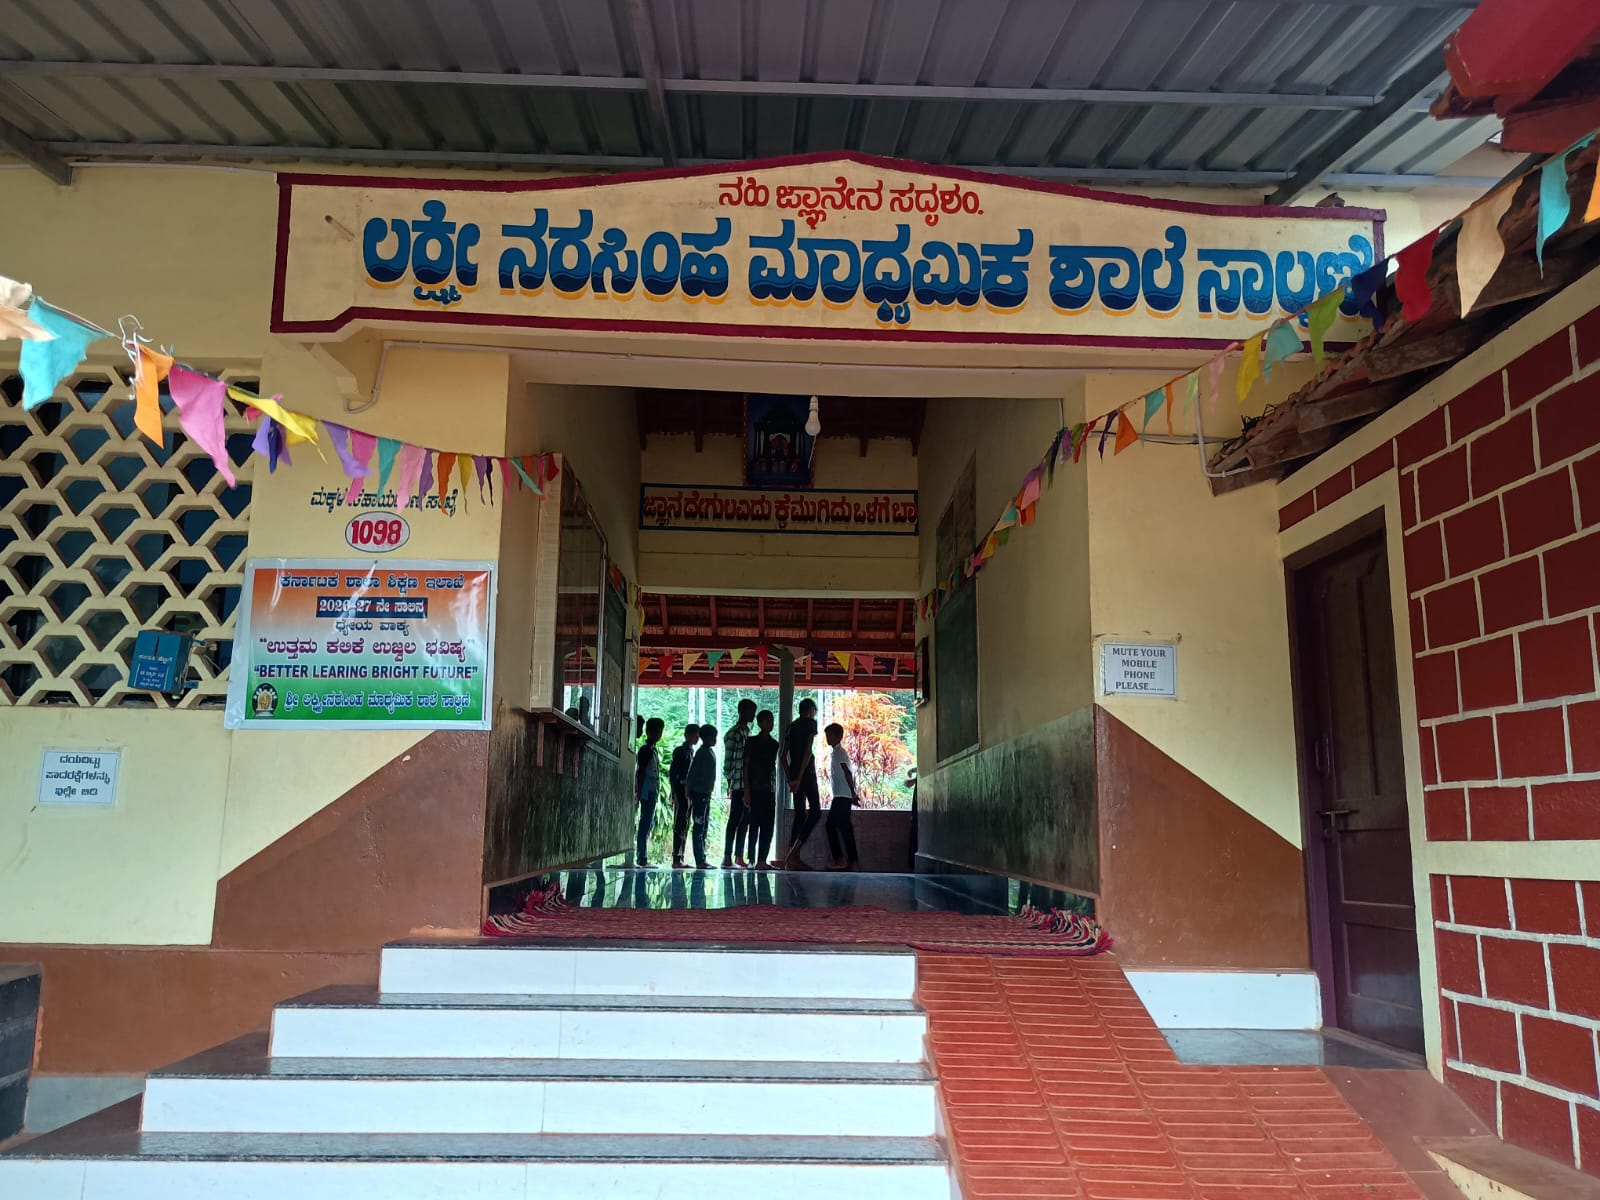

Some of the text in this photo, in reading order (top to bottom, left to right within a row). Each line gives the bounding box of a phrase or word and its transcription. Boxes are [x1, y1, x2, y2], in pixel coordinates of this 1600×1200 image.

[498, 207, 732, 304] ನರಸಿಂಹ
[748, 218, 1033, 326] ಮಾಧ್ಯಮಿಕ
[1048, 225, 1187, 314] ಶಾಲೆ
[351, 519, 403, 546] 1098
[279, 573, 339, 589] ಕರ್ನಾಟಕ
[425, 574, 465, 590] ಇಲಾಖೆ
[326, 637, 365, 655] ಕಲಿಕೆ
[1112, 647, 1166, 658] MUTE YOUR
[1121, 659, 1157, 668] MOBILE
[312, 665, 368, 679] LEARING
[371, 665, 420, 679] BRIGHT
[1124, 670, 1155, 680] PHONE
[417, 692, 439, 707] ಶಾಲೆ
